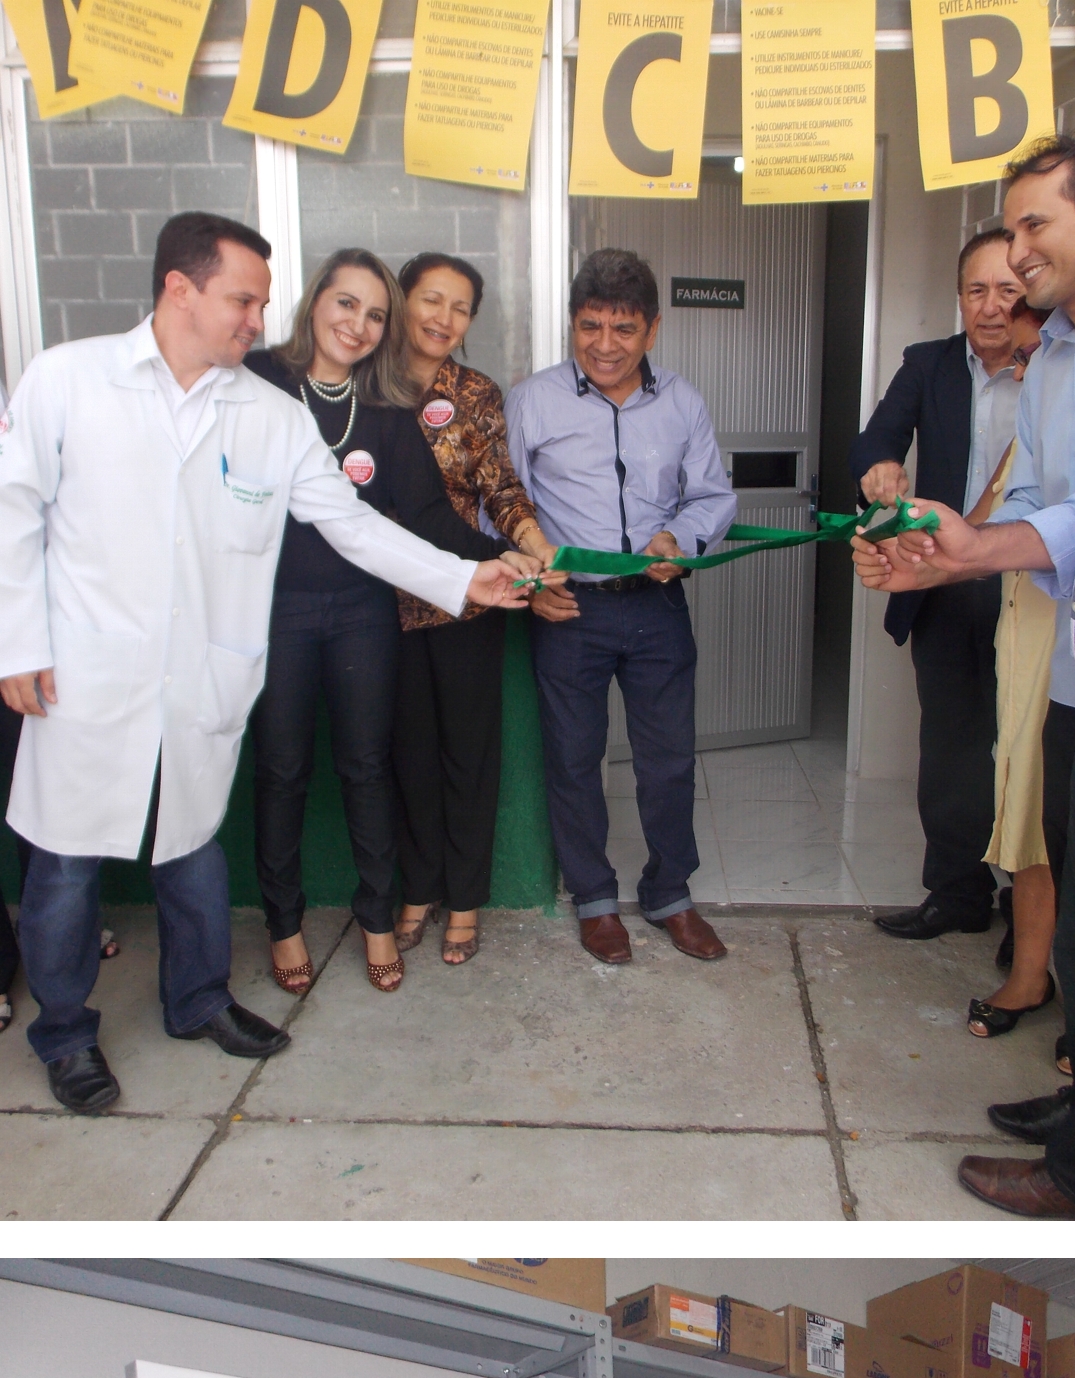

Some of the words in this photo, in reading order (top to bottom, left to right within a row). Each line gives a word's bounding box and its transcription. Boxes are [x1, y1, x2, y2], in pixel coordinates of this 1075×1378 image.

[253, 0, 352, 119] D
[608, 12, 632, 27] EVITE
[634, 15, 640, 28] A
[642, 16, 684, 29] HEPATITE
[602, 31, 683, 177] C
[942, 14, 1028, 164] B
[677, 287, 739, 301] FARMÁCIA
